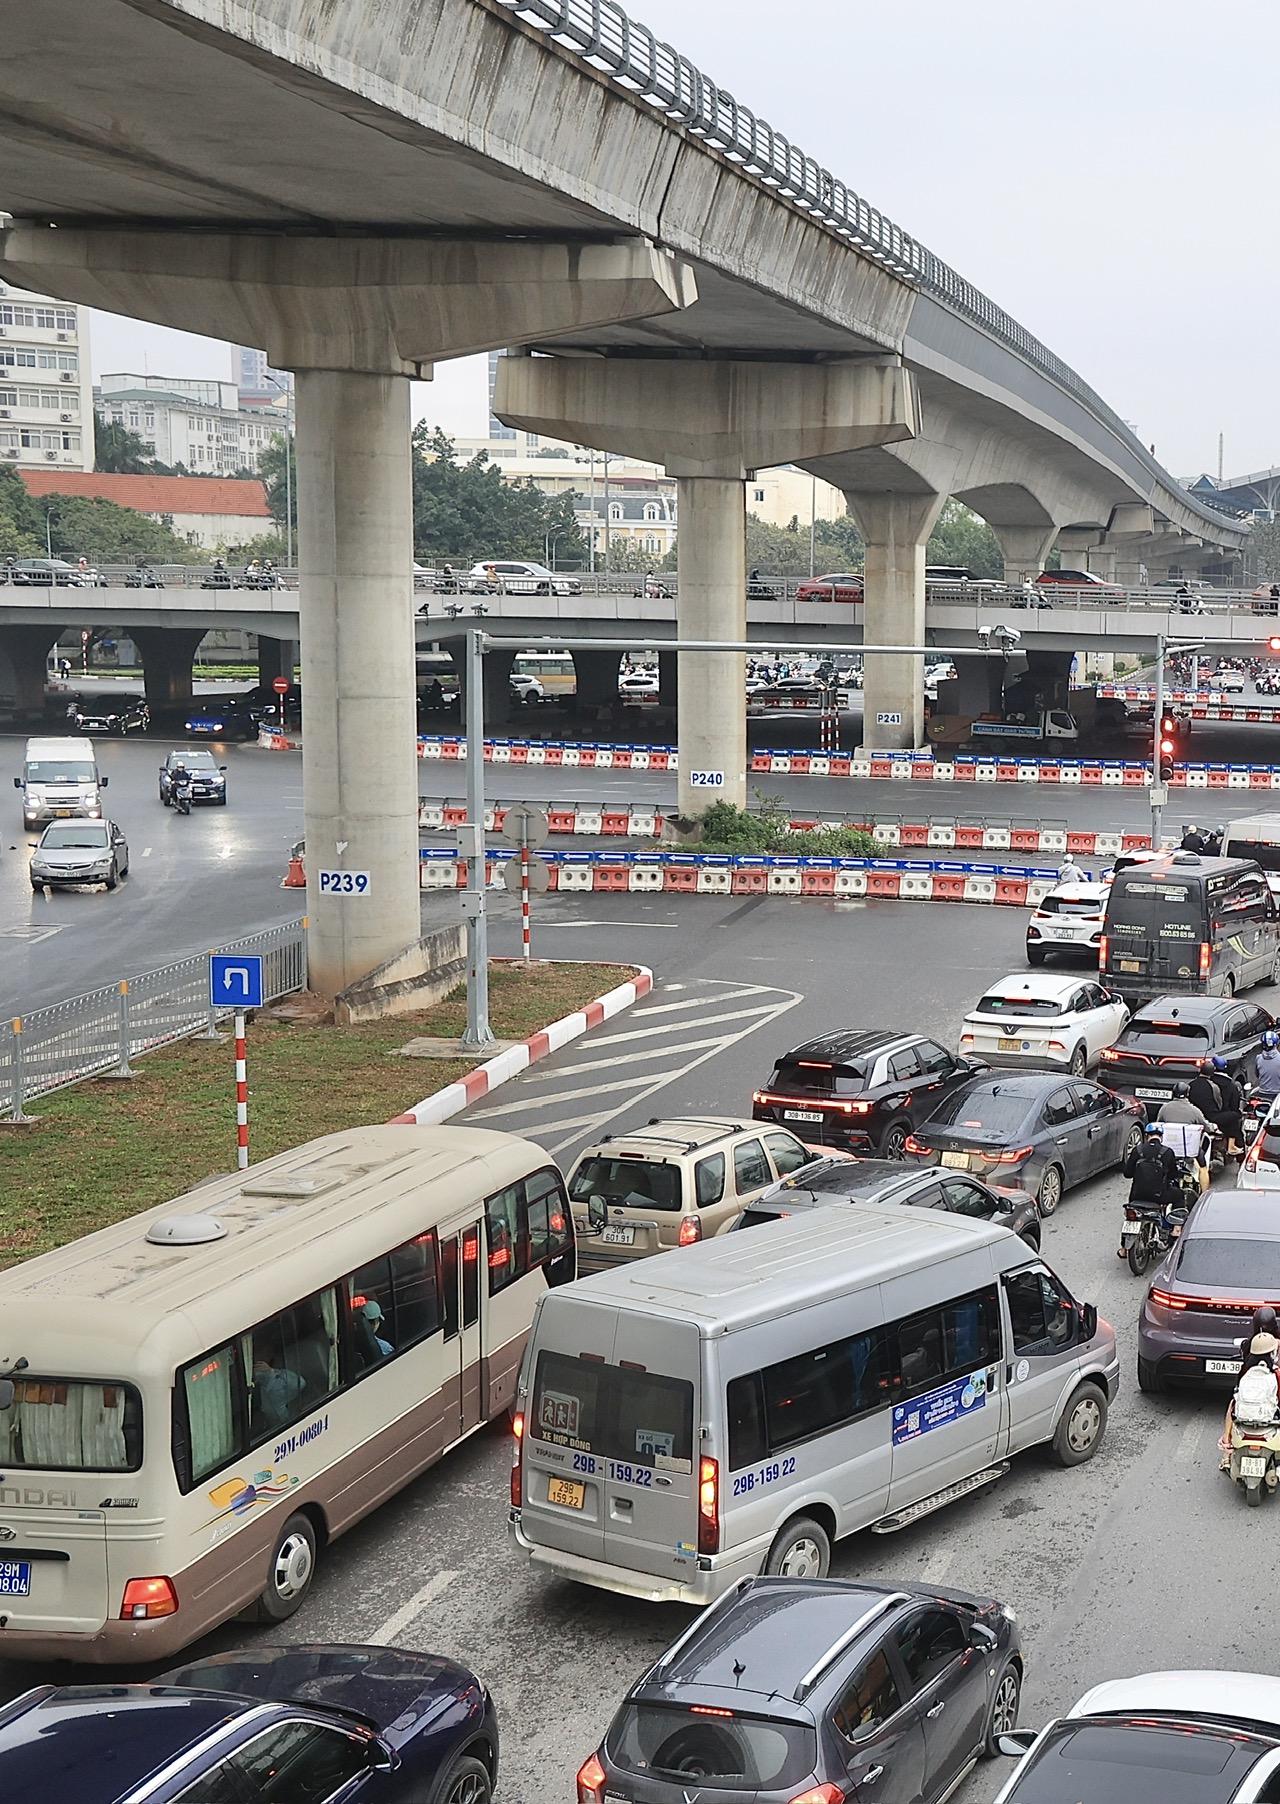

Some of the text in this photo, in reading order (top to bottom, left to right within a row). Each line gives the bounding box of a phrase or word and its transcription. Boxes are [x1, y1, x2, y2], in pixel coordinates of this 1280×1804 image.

[878, 714, 900, 723] P241
[692, 773, 722, 785] P240
[320, 872, 368, 893] P239
[611, 1226, 625, 1234] 30K
[605, 1234, 630, 1243] 601.91
[542, 1430, 591, 1452] XE HỢP ĐỒNG
[573, 1453, 596, 1474] 29B
[609, 1462, 652, 1487] 159.22
[558, 1481, 574, 1493] 29B
[552, 1491, 579, 1506] 159.22
